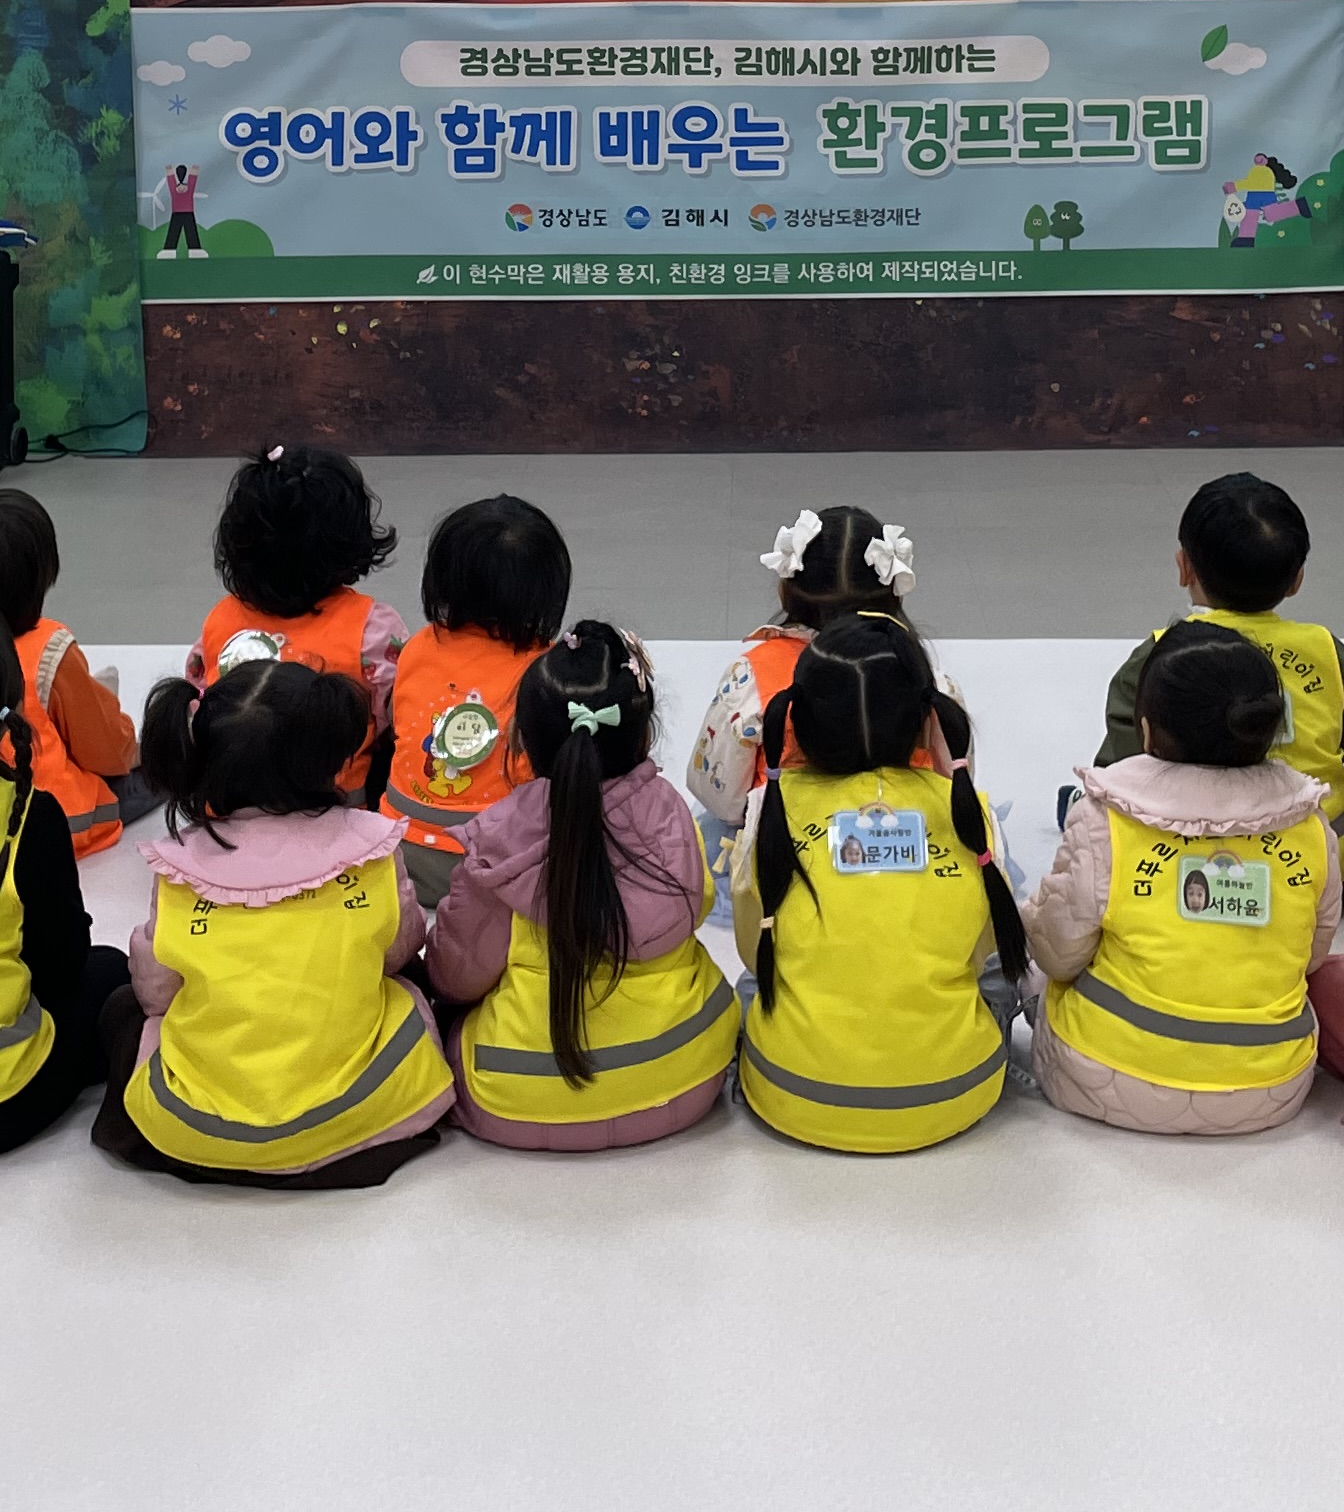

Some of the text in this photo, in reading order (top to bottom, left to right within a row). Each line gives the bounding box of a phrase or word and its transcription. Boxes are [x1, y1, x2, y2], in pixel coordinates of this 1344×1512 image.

[459, 43, 997, 78] 경상남도환경재단, 김해시와 함께하는
[223, 97, 1204, 177] 영어와 함께 배우는 환경프로그램
[538, 208, 609, 229] 경상남도
[784, 207, 922, 228] 경상남도환경재단
[443, 260, 1023, 286] 이 현수막은 재활용 용지, 친환경 잉크를 사용하여 제작되었습니다.
[866, 845, 916, 863] 문가비
[1208, 897, 1259, 917] 서하윤
